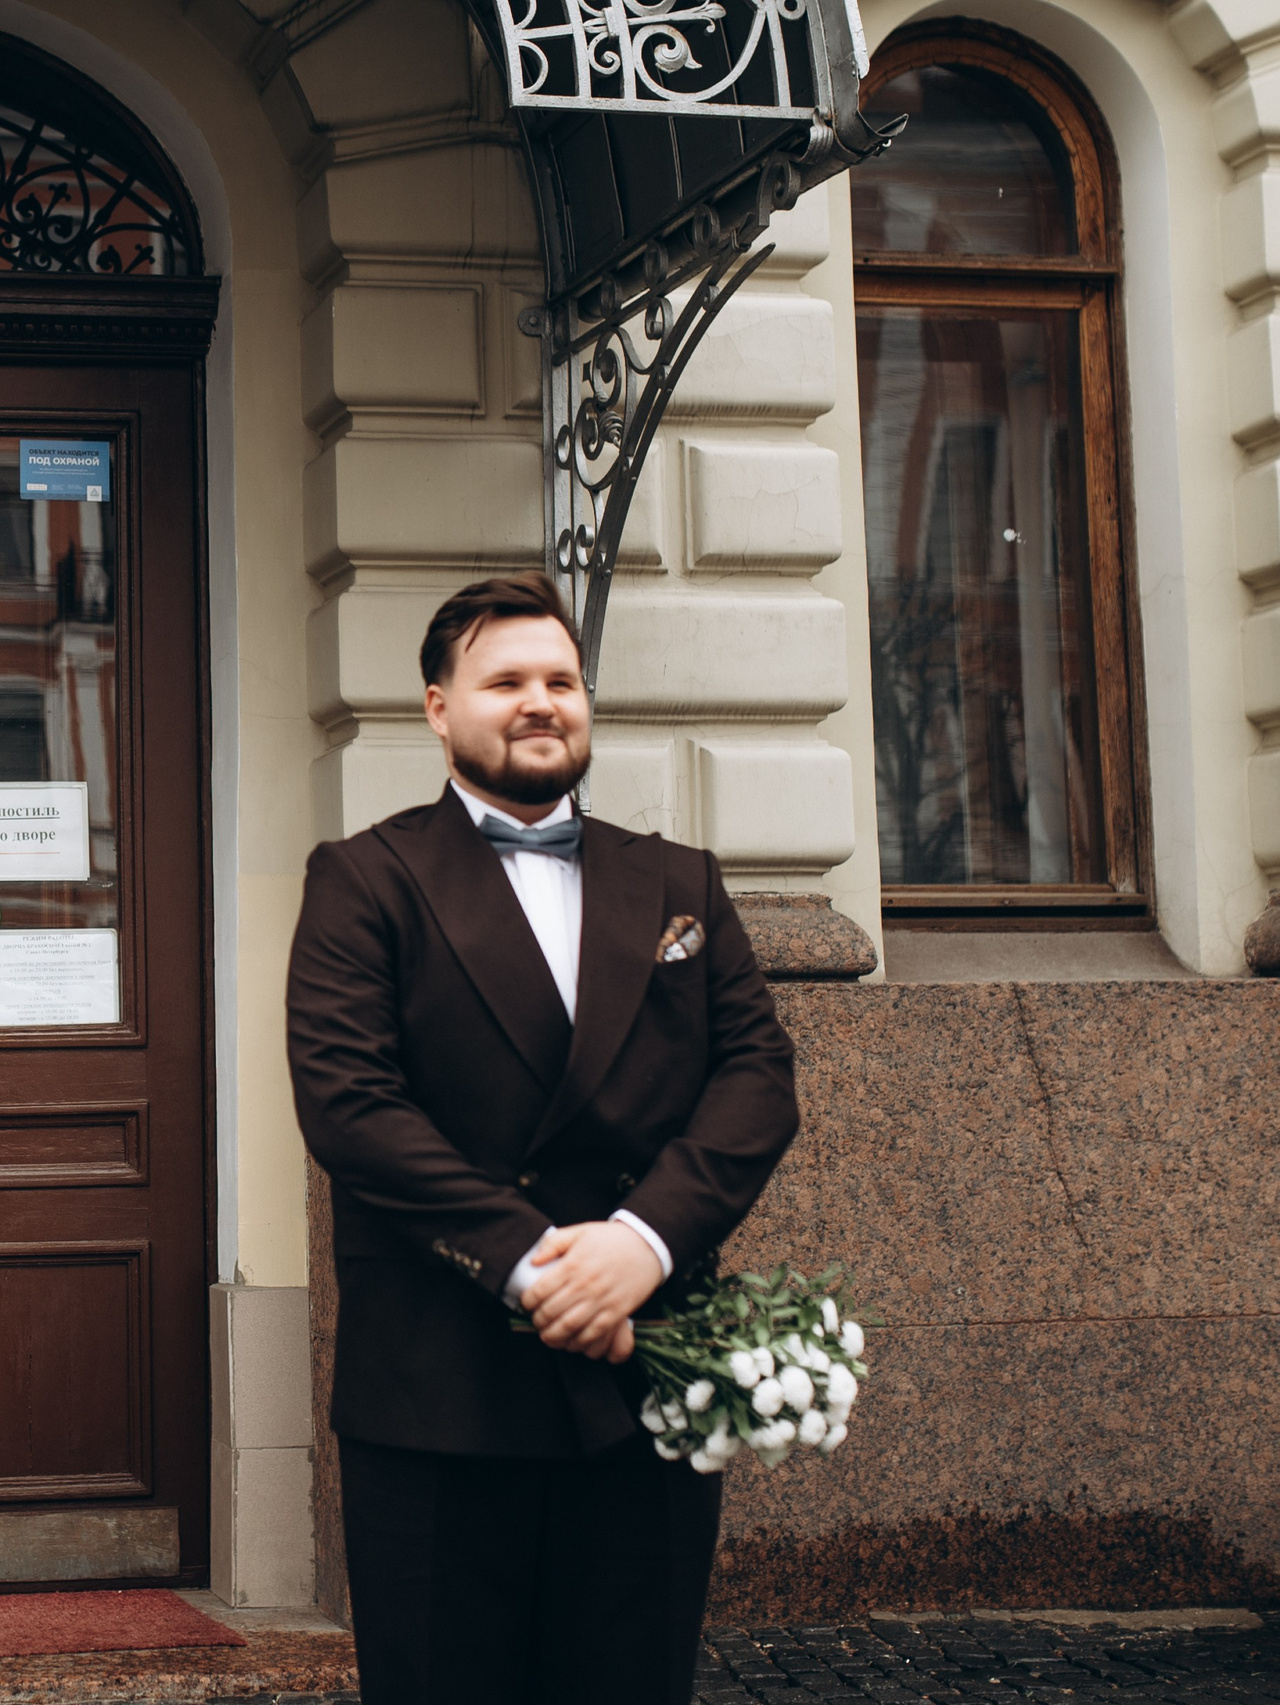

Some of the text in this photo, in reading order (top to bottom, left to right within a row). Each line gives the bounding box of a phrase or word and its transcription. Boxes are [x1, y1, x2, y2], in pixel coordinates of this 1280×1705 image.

[28, 456, 100, 466] ПОД ОХРАНОЙ
[12, 830, 56, 844] дворе
